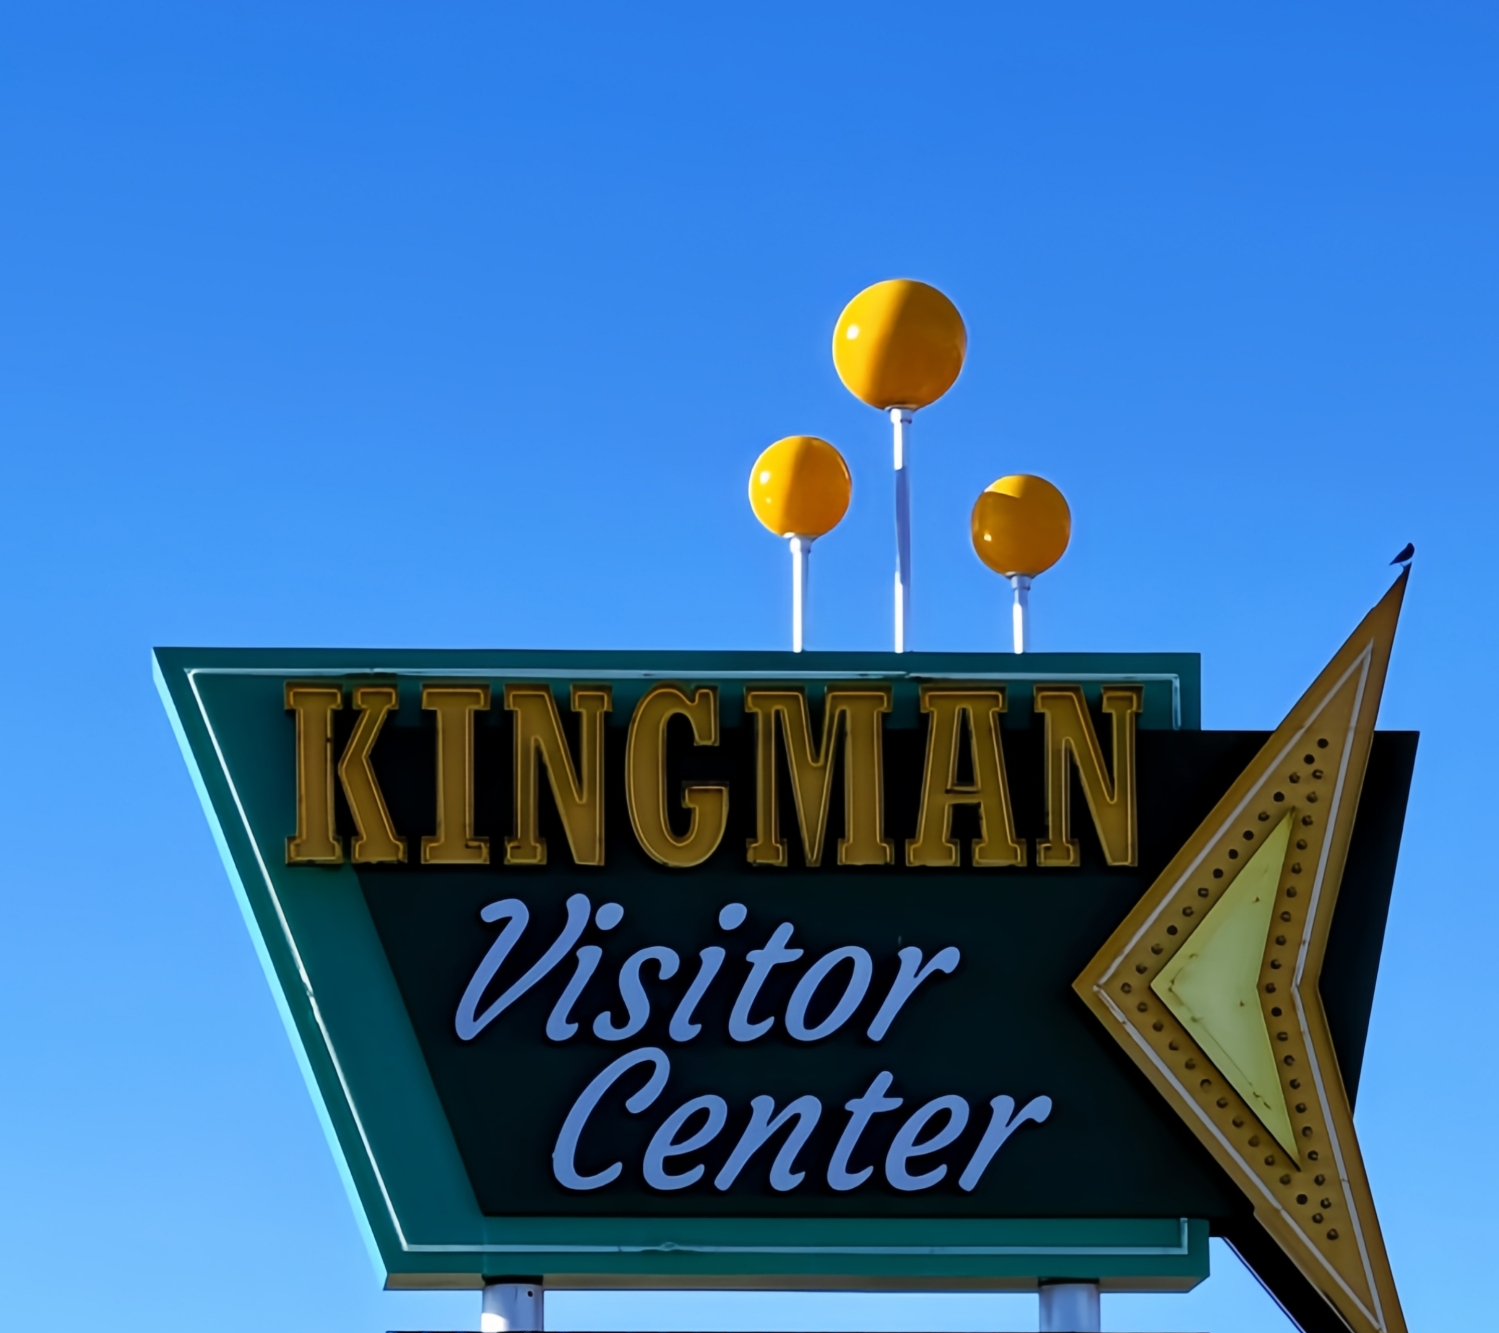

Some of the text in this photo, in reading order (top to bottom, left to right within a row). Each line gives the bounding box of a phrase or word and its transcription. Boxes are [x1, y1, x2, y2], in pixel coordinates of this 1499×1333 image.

[284, 682, 1142, 868] KINGMAN
[455, 893, 961, 1042] Visitor
[552, 1046, 1053, 1192] Center
